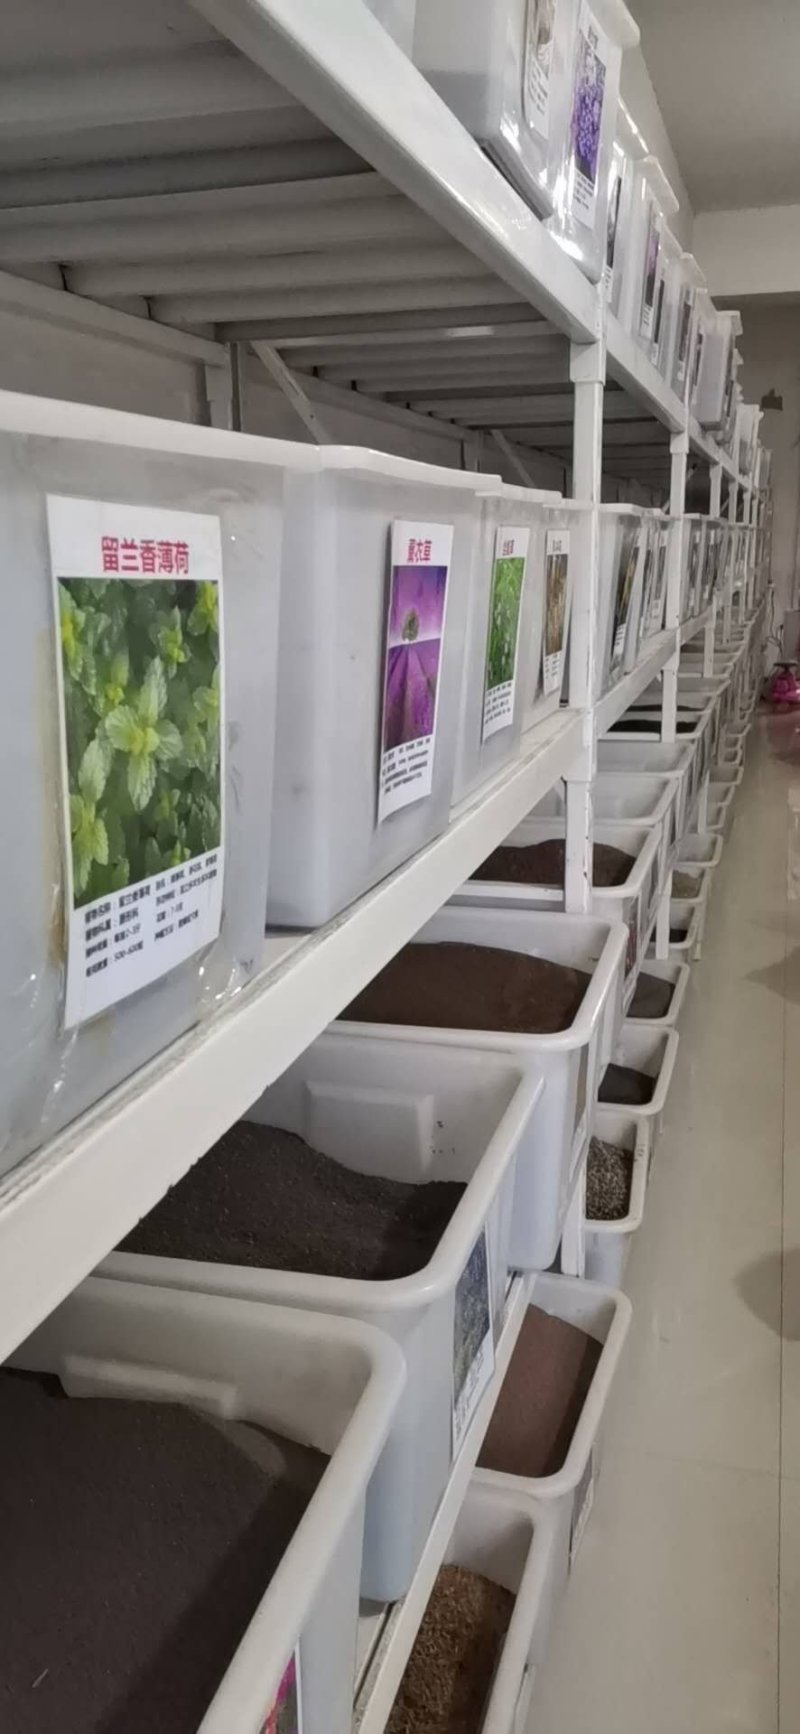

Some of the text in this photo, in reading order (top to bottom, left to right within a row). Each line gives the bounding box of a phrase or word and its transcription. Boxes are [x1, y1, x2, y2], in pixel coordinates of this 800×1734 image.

[101, 535, 189, 575] 留兰香薄荷
